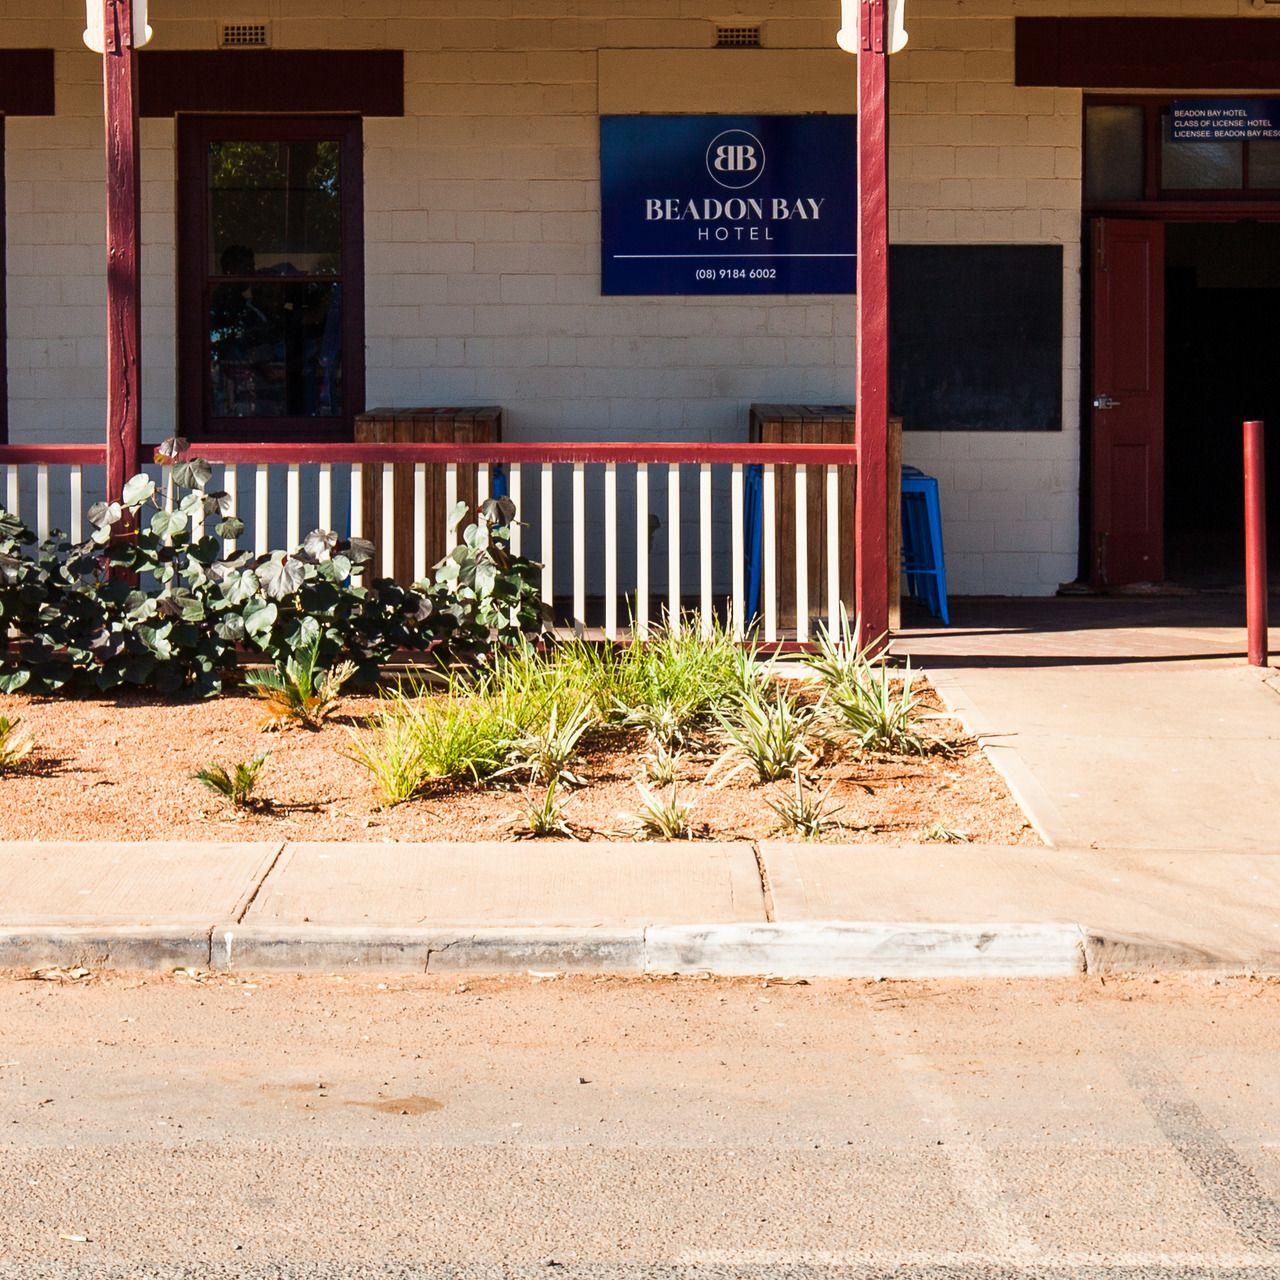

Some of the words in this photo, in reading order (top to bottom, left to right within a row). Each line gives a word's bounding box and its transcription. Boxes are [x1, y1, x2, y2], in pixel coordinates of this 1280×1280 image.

[1174, 109, 1206, 117] BEADON
[1207, 109, 1222, 117] BAY
[1222, 109, 1248, 117] HOTEL
[1174, 120, 1199, 128] CLASS
[1200, 120, 1211, 128] OF
[1174, 130, 1212, 138] LICENSEE:
[645, 198, 763, 220] BEADON
[772, 198, 825, 220] BAY
[698, 227, 773, 241] HOTEL
[695, 269, 716, 280] (08)
[719, 269, 746, 279] 9184
[749, 269, 776, 279] 6002
